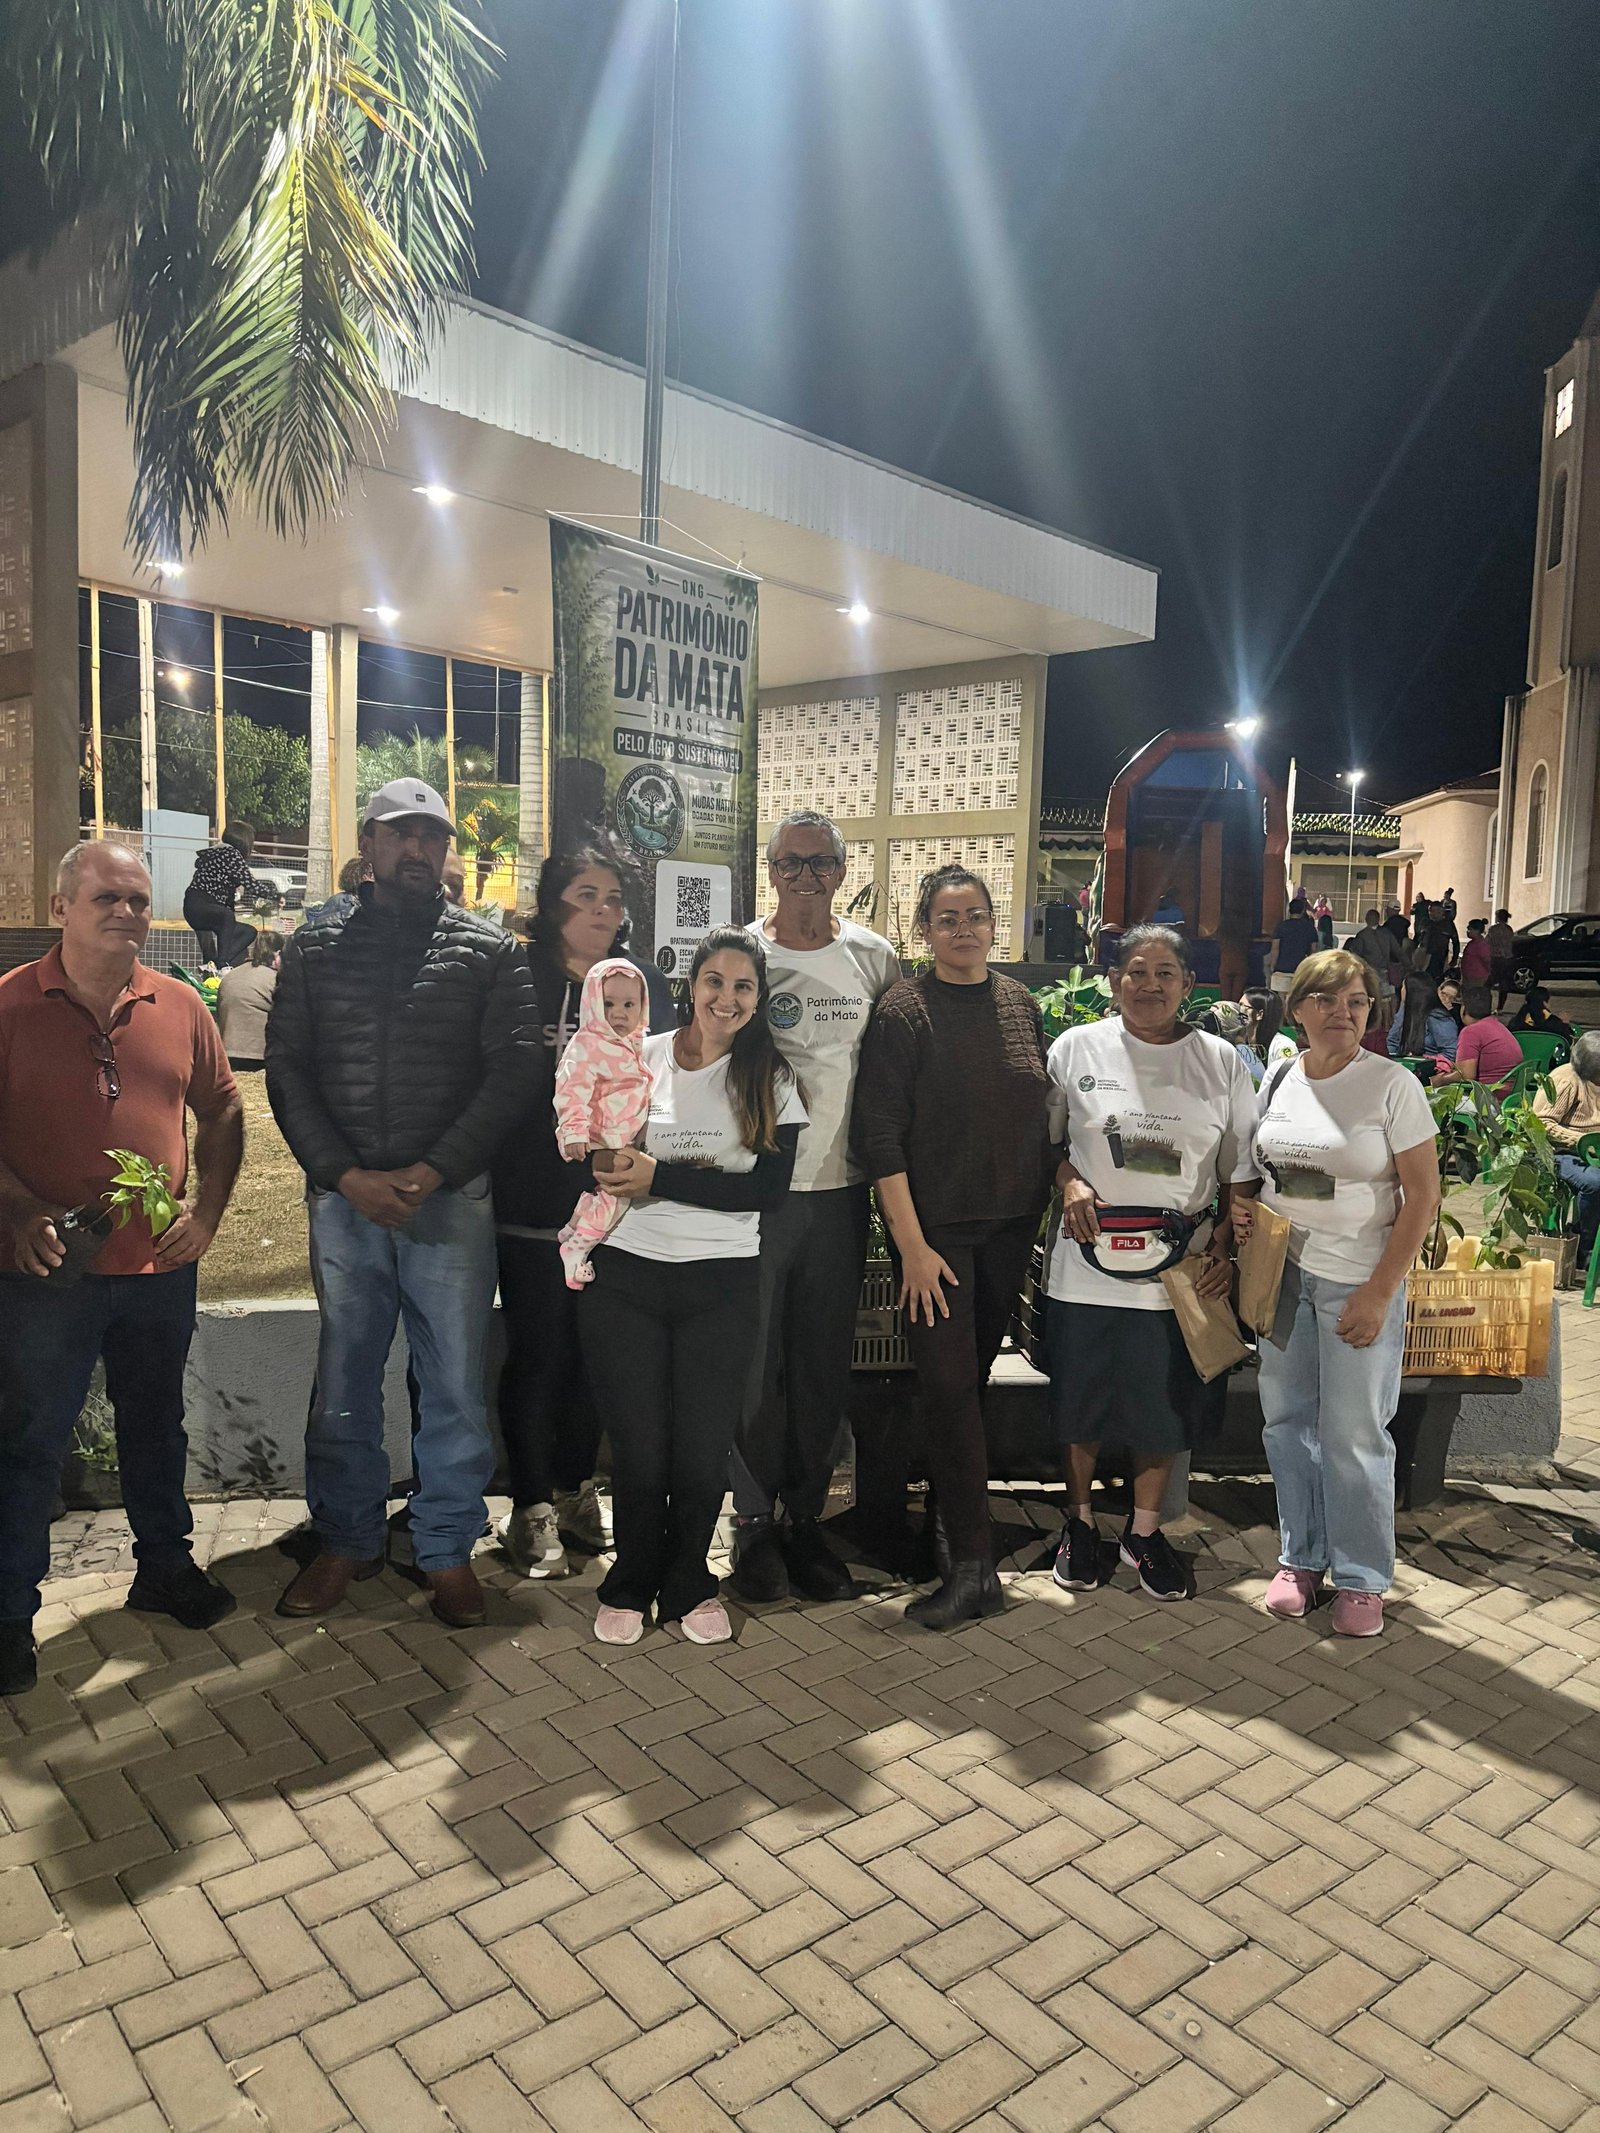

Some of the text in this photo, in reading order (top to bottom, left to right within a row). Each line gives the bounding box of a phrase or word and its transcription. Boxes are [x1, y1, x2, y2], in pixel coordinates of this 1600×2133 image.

[682, 579, 704, 599] ONG
[616, 584, 748, 662] PATRIMÔNIO
[614, 636, 745, 723] DA MATA
[653, 710, 711, 736] BRASIL
[617, 732, 645, 753] PELO
[647, 737, 675, 758] AGRO
[692, 794, 715, 810] MUDAS
[807, 995, 863, 1008] Patrimônio
[814, 1010, 858, 1022] da Mata
[1144, 1112, 1182, 1122] plantando
[1136, 1119, 1164, 1132] vida.
[679, 1129, 723, 1139] plantando
[671, 1136, 704, 1150] vida.
[1284, 1147, 1312, 1159] vida.
[1116, 1239, 1140, 1248] FILA
